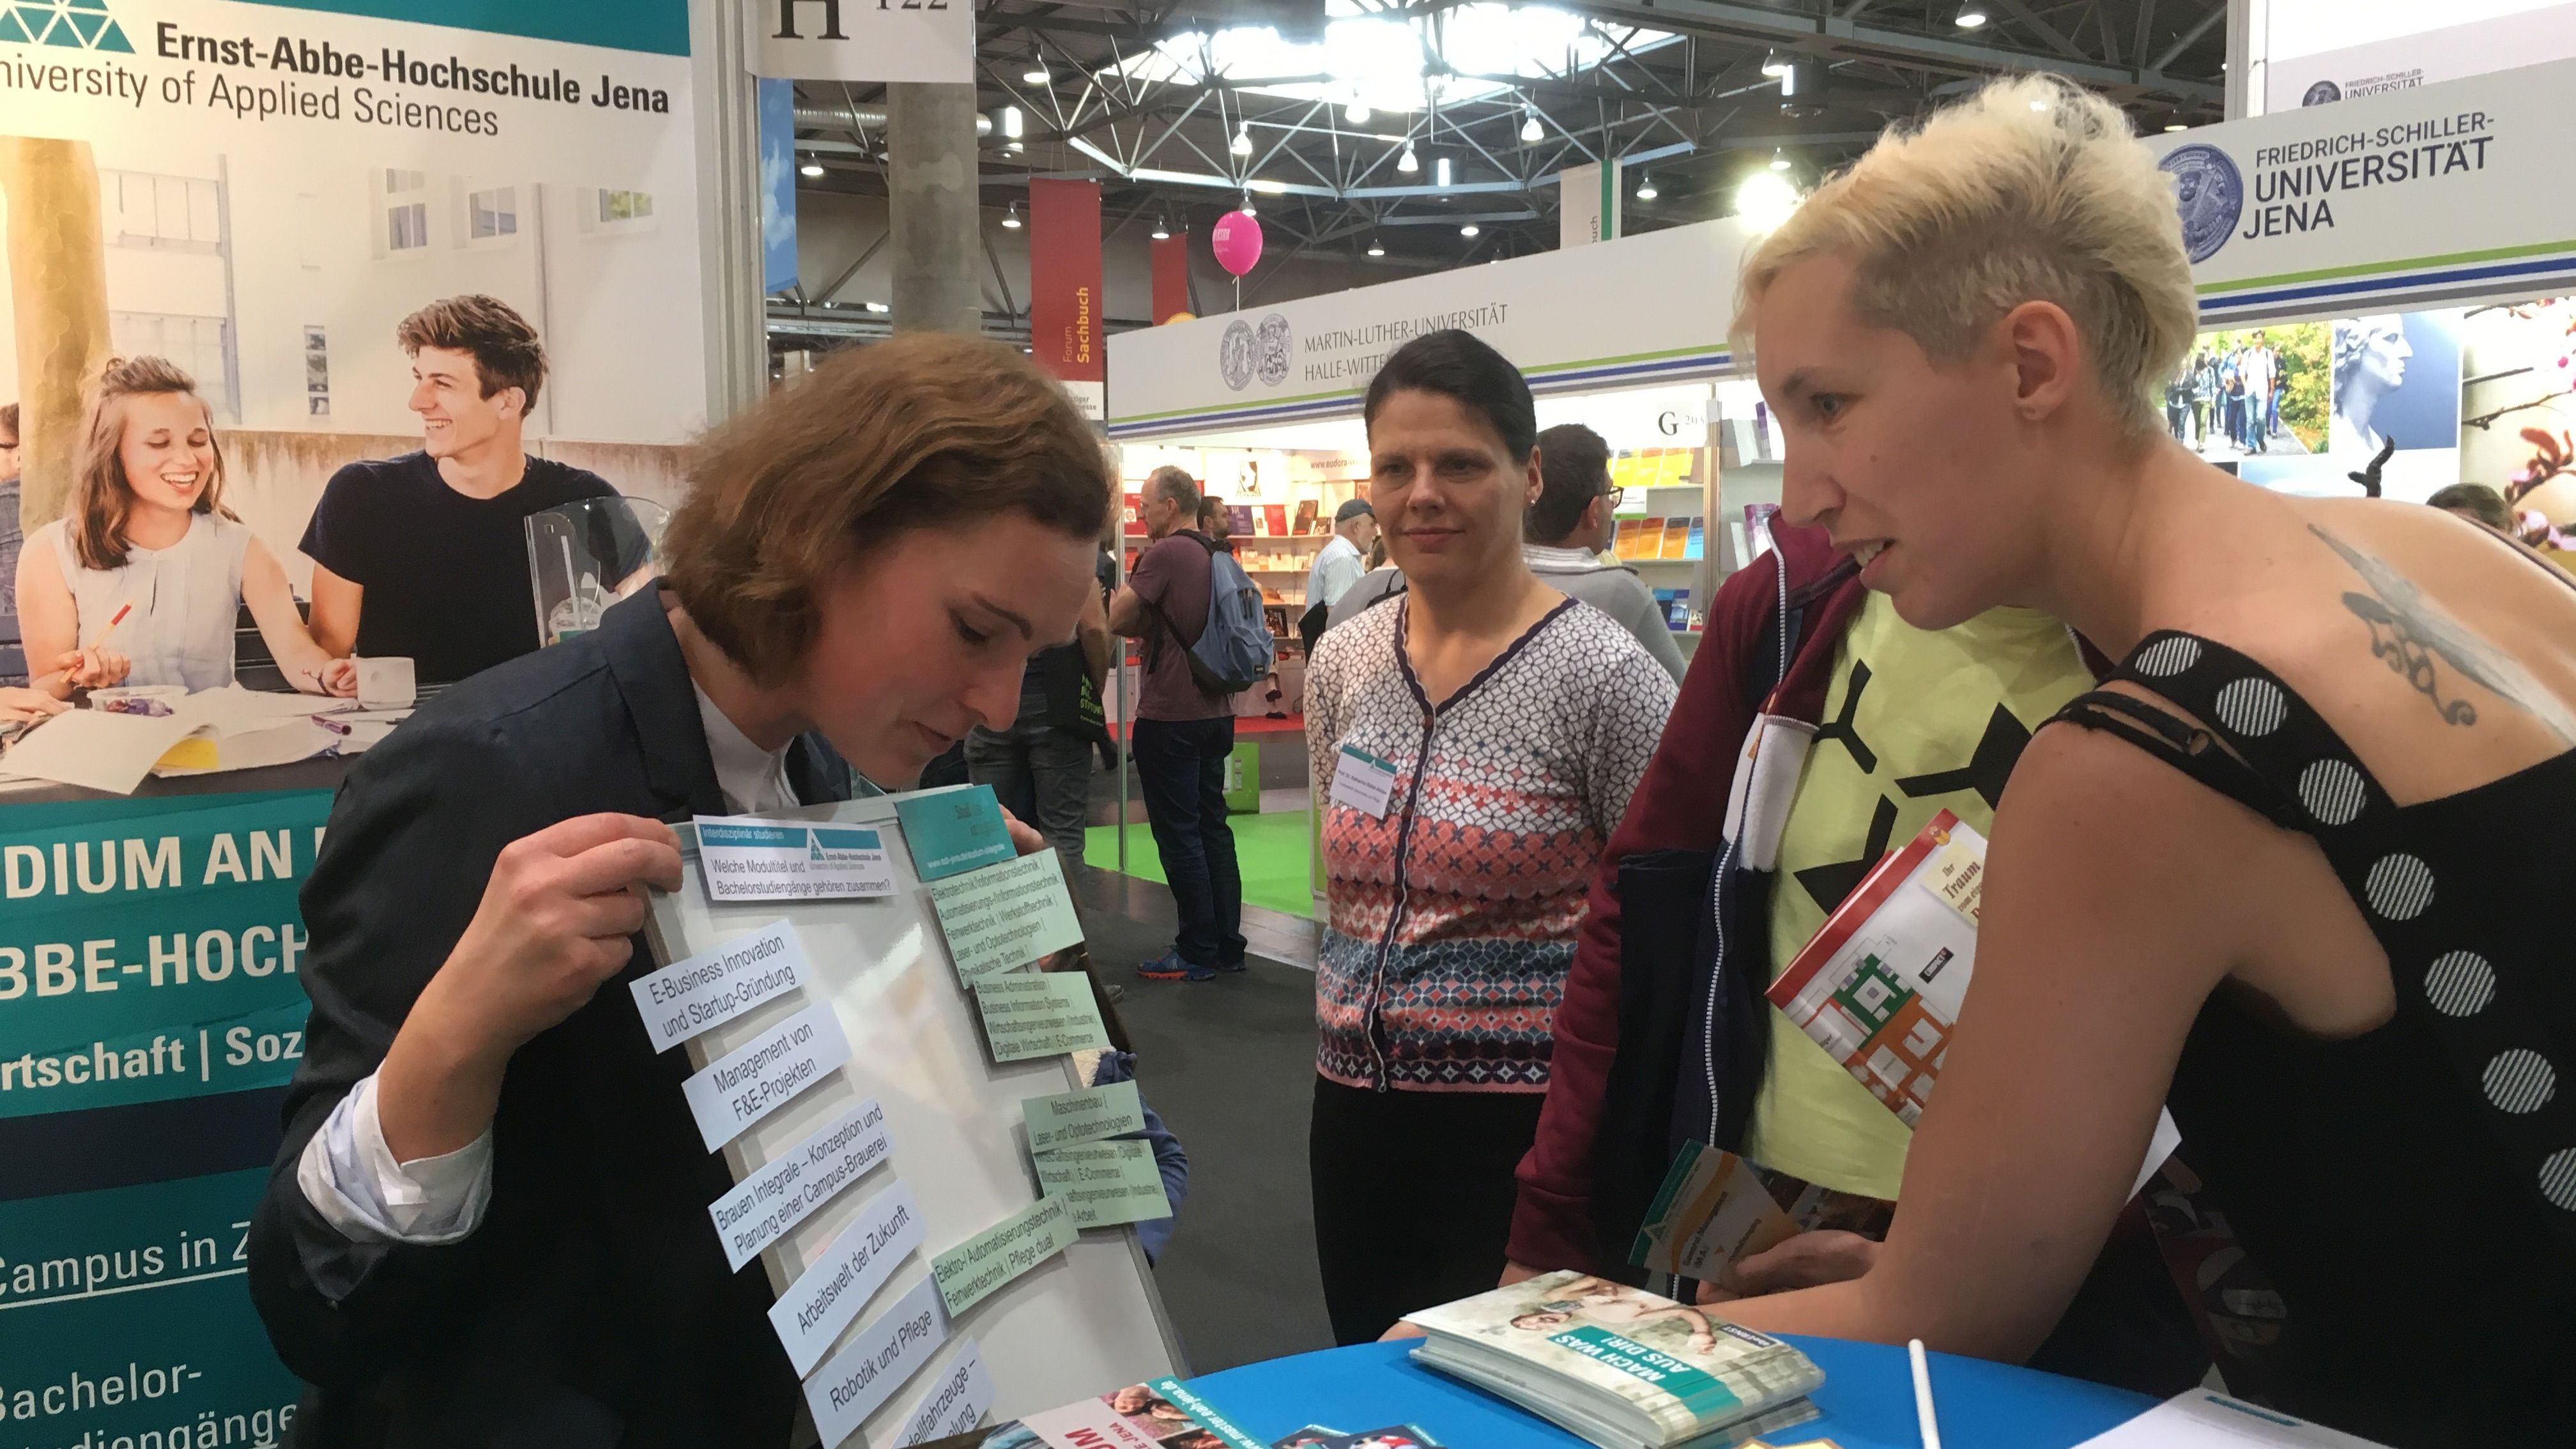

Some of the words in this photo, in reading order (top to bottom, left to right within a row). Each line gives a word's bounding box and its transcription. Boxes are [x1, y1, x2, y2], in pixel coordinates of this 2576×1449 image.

[157, 21, 581, 103] Ernst-Abbe-Hochschule
[591, 74, 669, 114] Jena
[162, 70, 196, 105] of
[208, 73, 341, 122] Applied
[354, 87, 499, 136] Sciences
[2255, 135, 2494, 203] UNIVERSITÄT
[2256, 111, 2496, 168] FRIEDRICH-SCHILLER-
[2242, 199, 2335, 240] JENA
[1062, 326, 1073, 363] Forum
[1077, 286, 1090, 364] Sachbuch
[1304, 302, 1509, 354] MARTIN-LUTHER-UNIVERSITÄT
[1658, 411, 1679, 436] G
[4, 836, 182, 899] DIUM
[202, 828, 293, 885] AN
[710, 859, 746, 874] Welche
[747, 859, 788, 874] Modultitel
[790, 859, 806, 873] und
[716, 880, 812, 896] Bachelorstudiengänge
[813, 879, 845, 896] gehören
[847, 878, 891, 893] zusammen?
[1942, 860, 1982, 900] Traum
[648, 960, 724, 1006] E-Business
[722, 935, 786, 974] Innovation
[662, 1008, 690, 1038] und
[688, 964, 797, 1025] Startup-Gründung
[1, 1035, 186, 1091] rtschaft
[225, 1025, 303, 1066] Soz
[713, 1034, 792, 1094] Management
[791, 1022, 814, 1046] von
[732, 1057, 818, 1122] F&E-Projekten
[715, 1192, 756, 1232] Brauen
[752, 1160, 801, 1205] Integrale
[807, 1121, 864, 1167] Konzeption
[862, 1102, 884, 1129] und
[733, 1213, 780, 1257] Planung
[778, 1193, 804, 1225] einer
[802, 1131, 889, 1204] Campus-Brauerei
[0, 1245, 165, 1298] ampus
[180, 1230, 217, 1269] in
[797, 1266, 855, 1336] Arbeitswelt
[852, 1245, 871, 1274] der
[866, 1204, 911, 1255] Zukunft
[1008, 1247, 1036, 1270] Pflege
[1036, 1232, 1055, 1255] dual
[829, 1358, 879, 1413] Robotik
[877, 1335, 900, 1370] und
[898, 1309, 933, 1350] Pflege
[1554, 1334, 1605, 1360] WAS
[1600, 1335, 1648, 1358] DIR!
[1605, 1352, 1666, 1383] MACH
[1642, 1352, 1692, 1374] AUS
[1108, 1421, 1139, 1443] JENA
